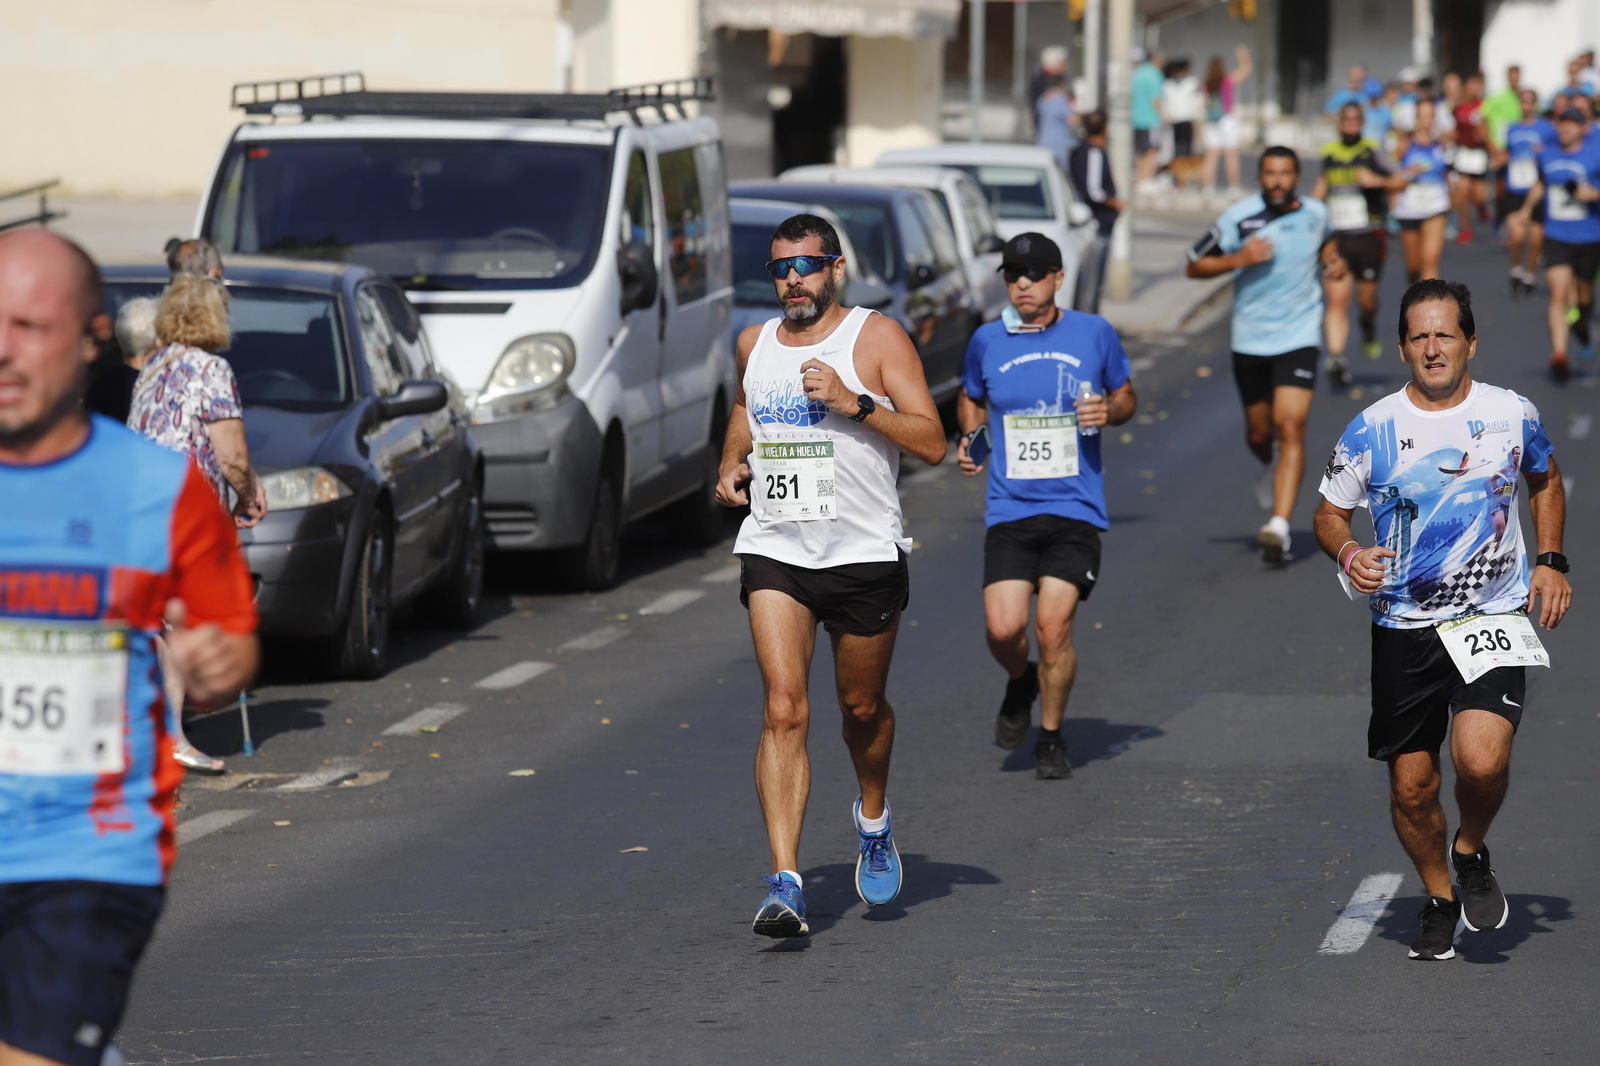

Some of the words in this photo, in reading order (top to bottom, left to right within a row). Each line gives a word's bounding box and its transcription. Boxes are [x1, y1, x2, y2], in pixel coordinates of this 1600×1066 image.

[751, 378, 804, 394] RUNNE
[1485, 420, 1510, 431] HUELVA
[765, 446, 788, 457] VUELTA
[789, 447, 795, 457] A
[797, 445, 827, 457] HUELVA
[1018, 442, 1052, 460] 255
[766, 474, 799, 499] 251
[1451, 620, 1478, 634] MIGUEL
[1464, 628, 1512, 657] 236
